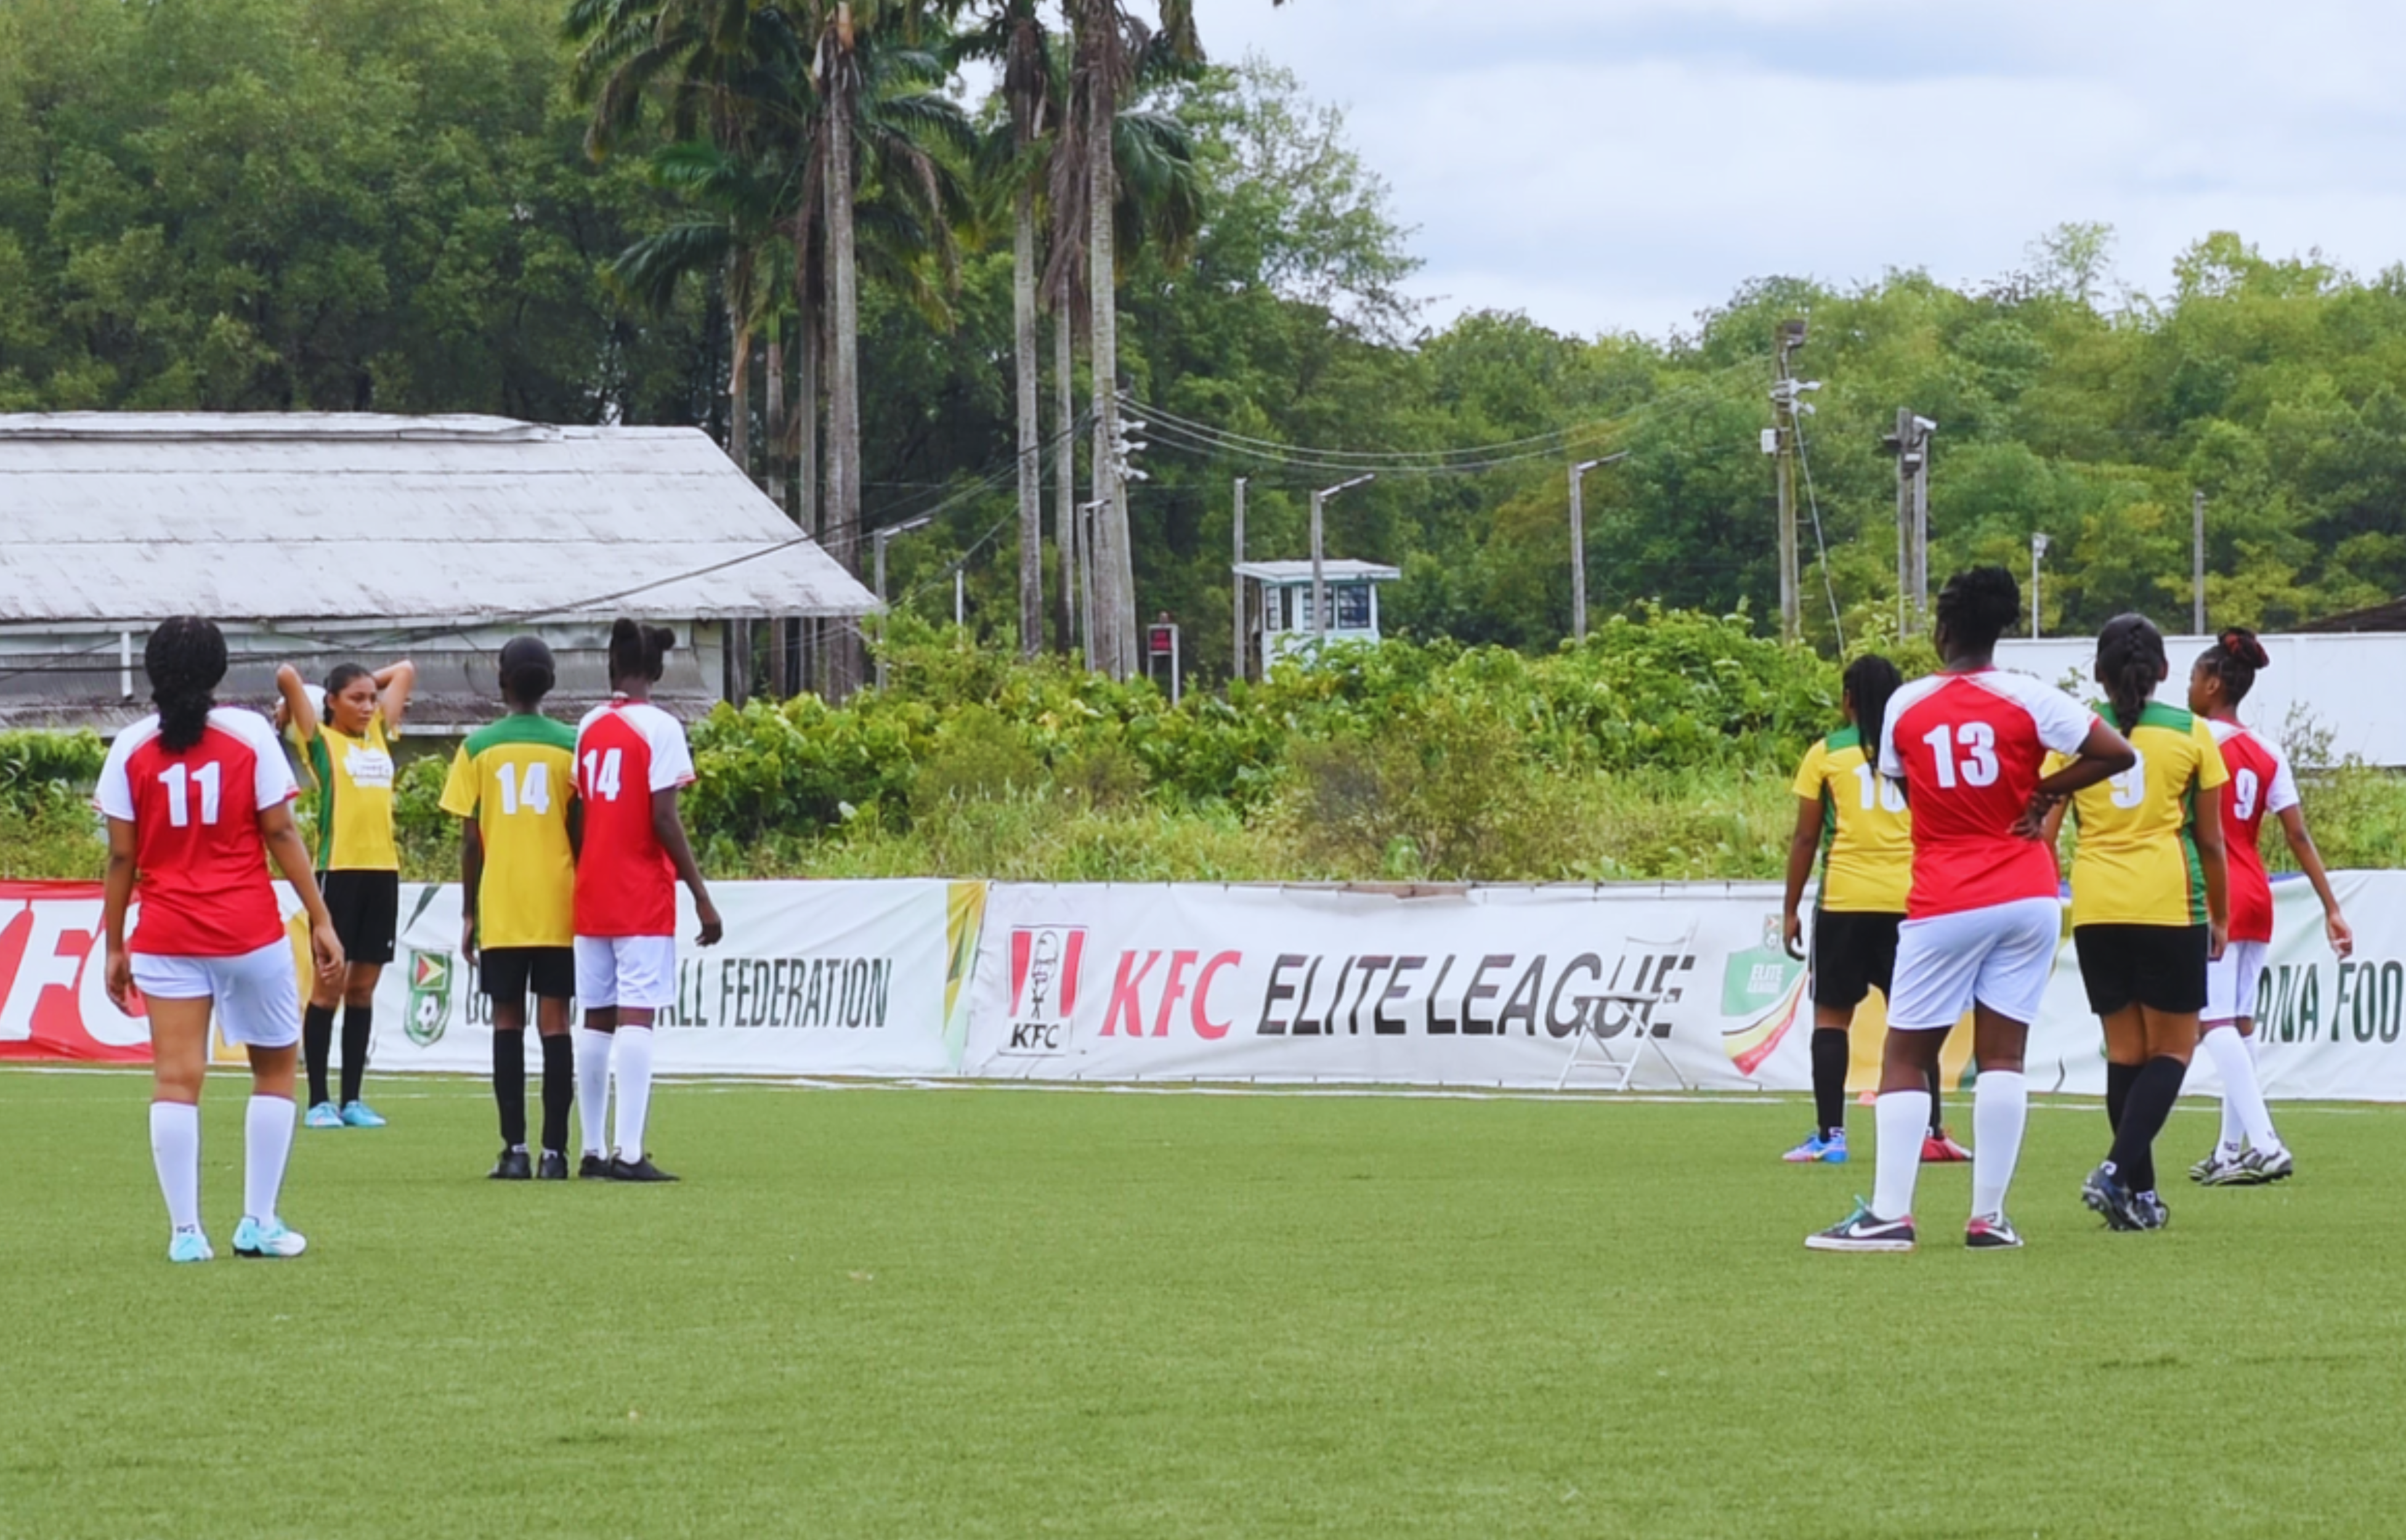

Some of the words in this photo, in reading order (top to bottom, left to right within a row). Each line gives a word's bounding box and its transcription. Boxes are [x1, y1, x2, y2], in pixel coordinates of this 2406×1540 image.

[582, 747, 623, 802] 14
[1922, 721, 1999, 788] 13
[158, 761, 221, 827] 11
[495, 761, 550, 815] 14
[2234, 768, 2259, 821] 9
[719, 957, 892, 1028] FEDERATION
[1098, 950, 1242, 1040] KFC
[1256, 955, 1428, 1035] ELITE
[1426, 952, 1696, 1039] LEAGUE
[1010, 1023, 1060, 1049] KFC
